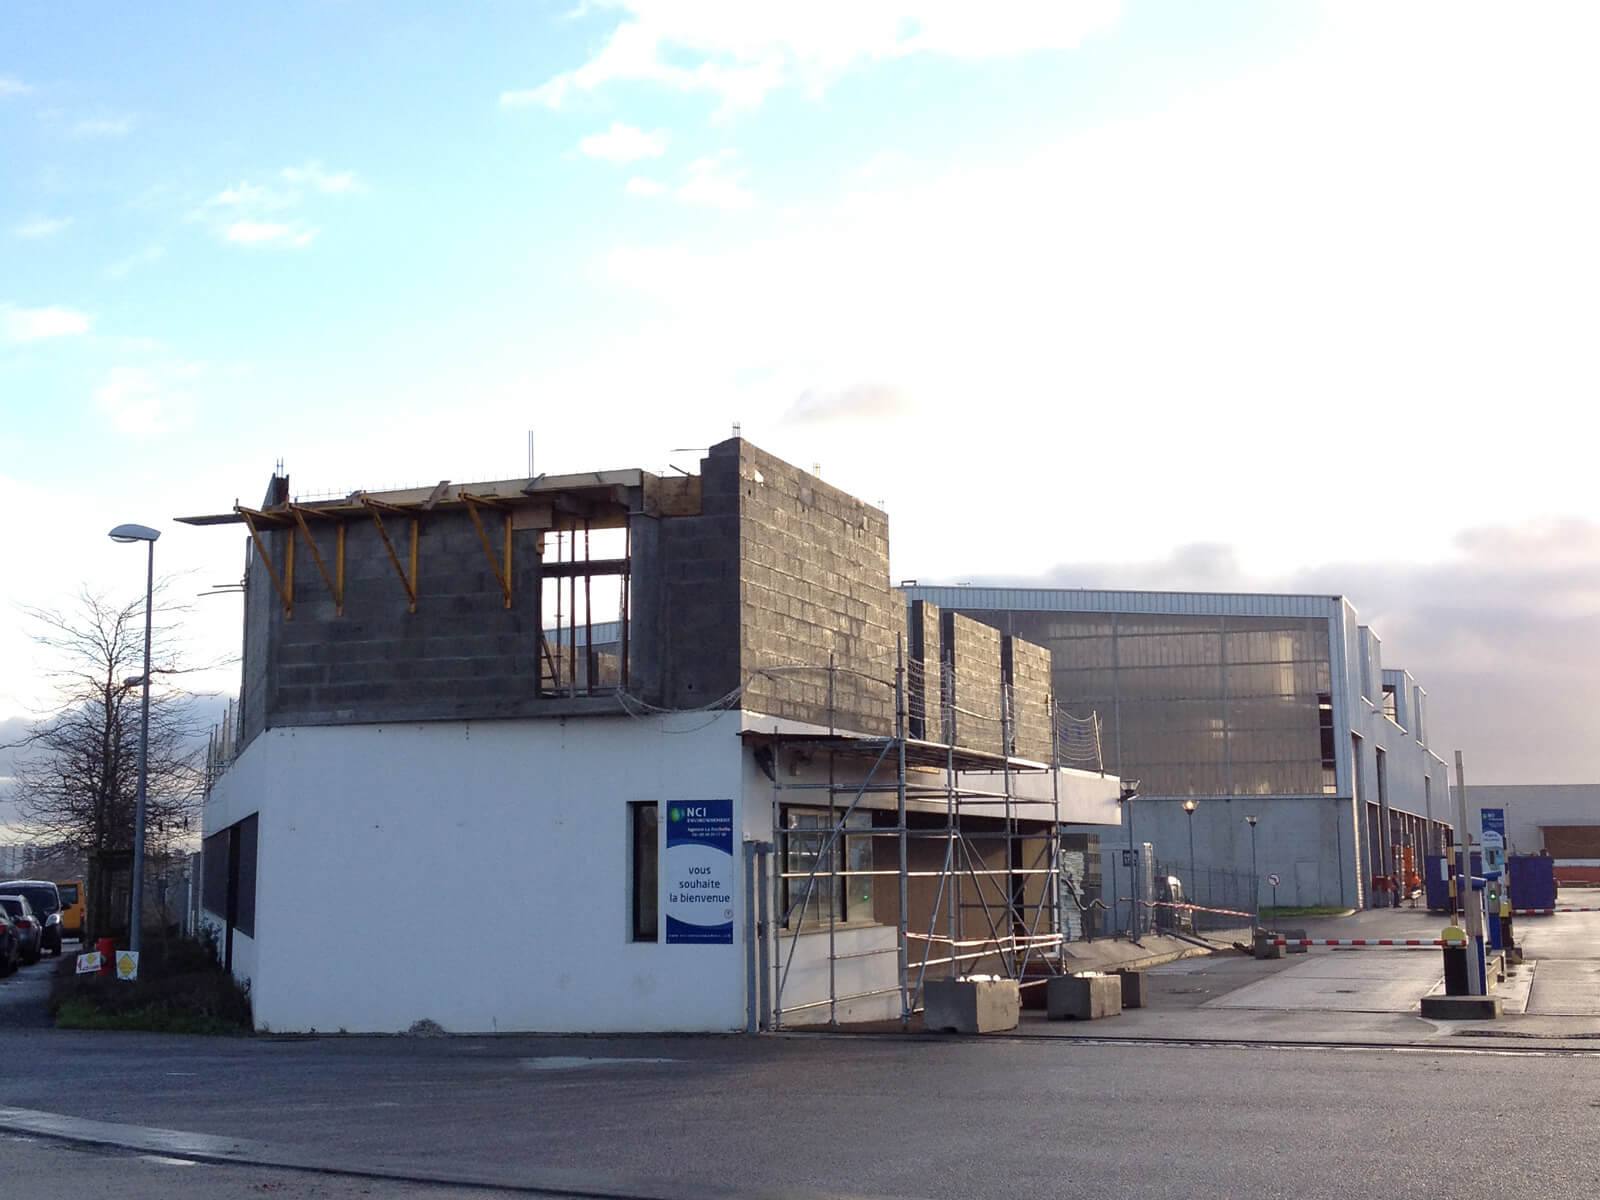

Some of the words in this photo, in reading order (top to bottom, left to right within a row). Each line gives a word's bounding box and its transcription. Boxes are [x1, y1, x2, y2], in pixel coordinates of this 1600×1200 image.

[687, 807, 706, 817] NCI
[688, 867, 711, 875] vous
[679, 879, 721, 889] souhaite
[669, 893, 678, 903] la
[680, 893, 730, 903] bienvenue
